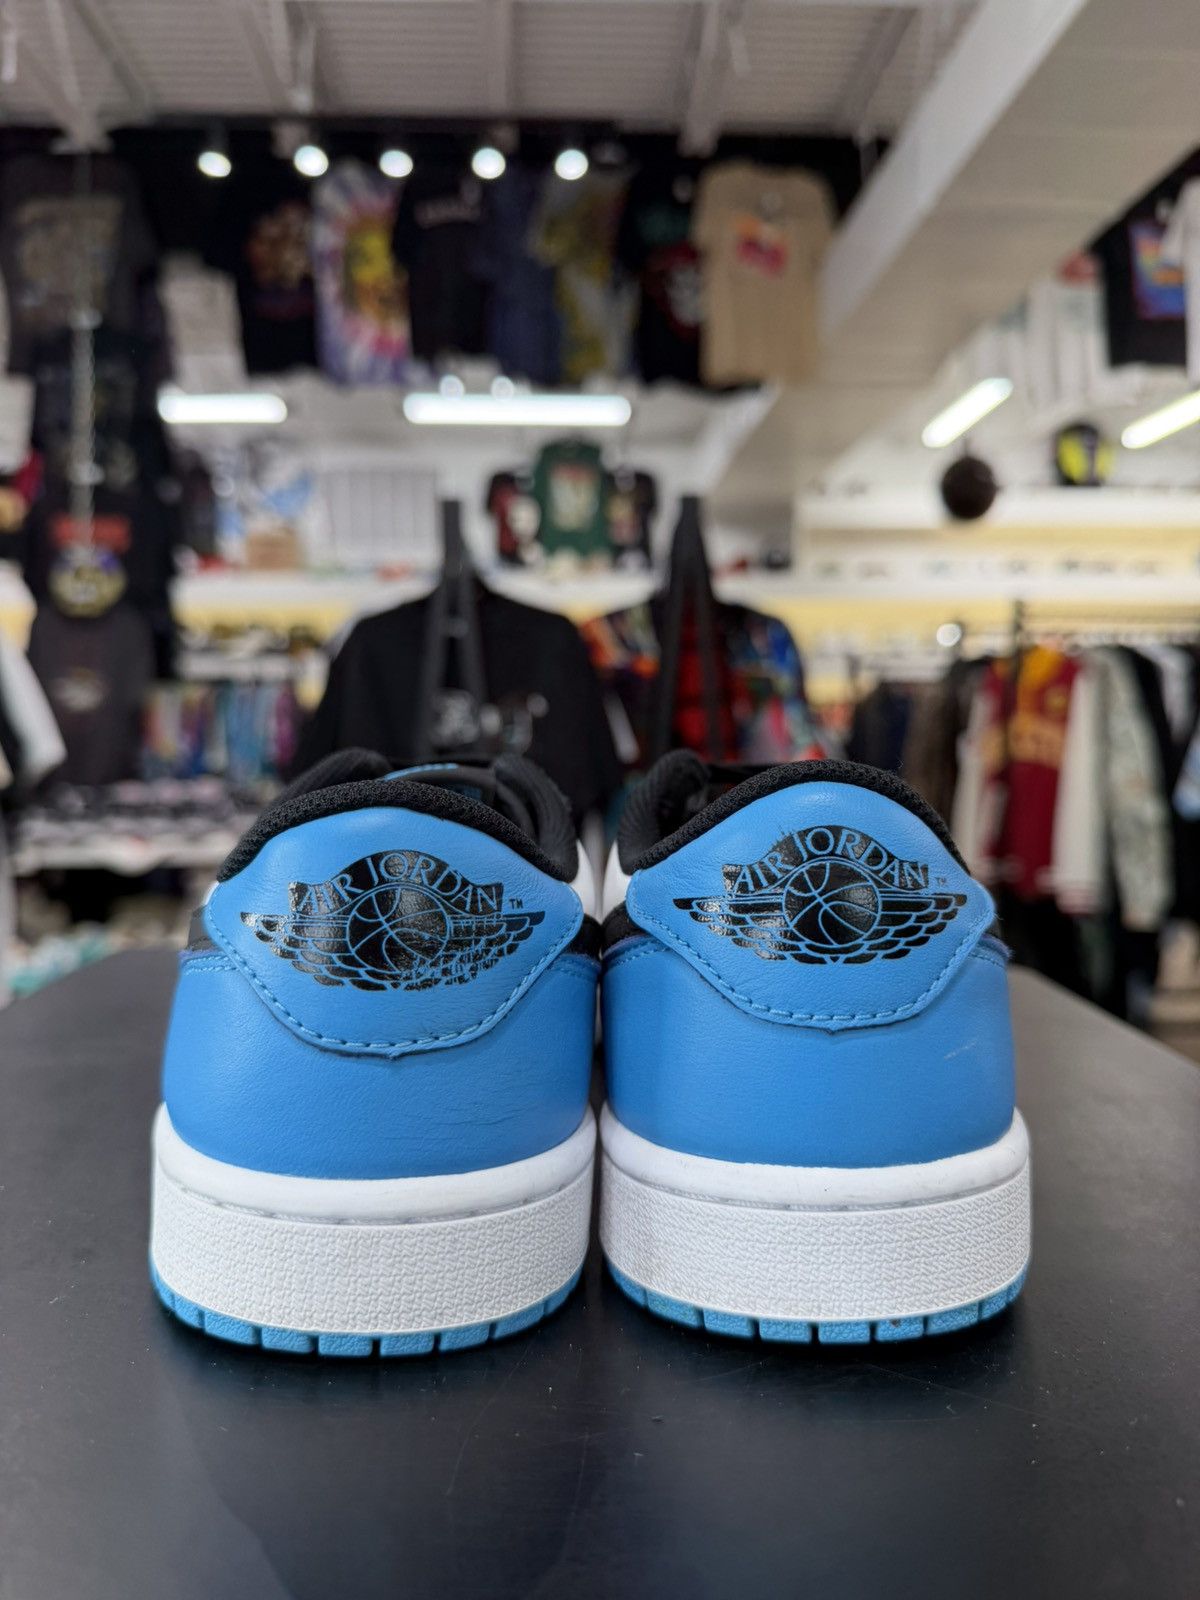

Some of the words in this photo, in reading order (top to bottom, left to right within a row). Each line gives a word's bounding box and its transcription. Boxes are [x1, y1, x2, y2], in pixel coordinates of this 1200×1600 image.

[300, 873, 363, 913] AIR
[366, 853, 499, 911] JORDAN
[733, 852, 796, 893] AIR
[792, 827, 929, 889] JORDAN
